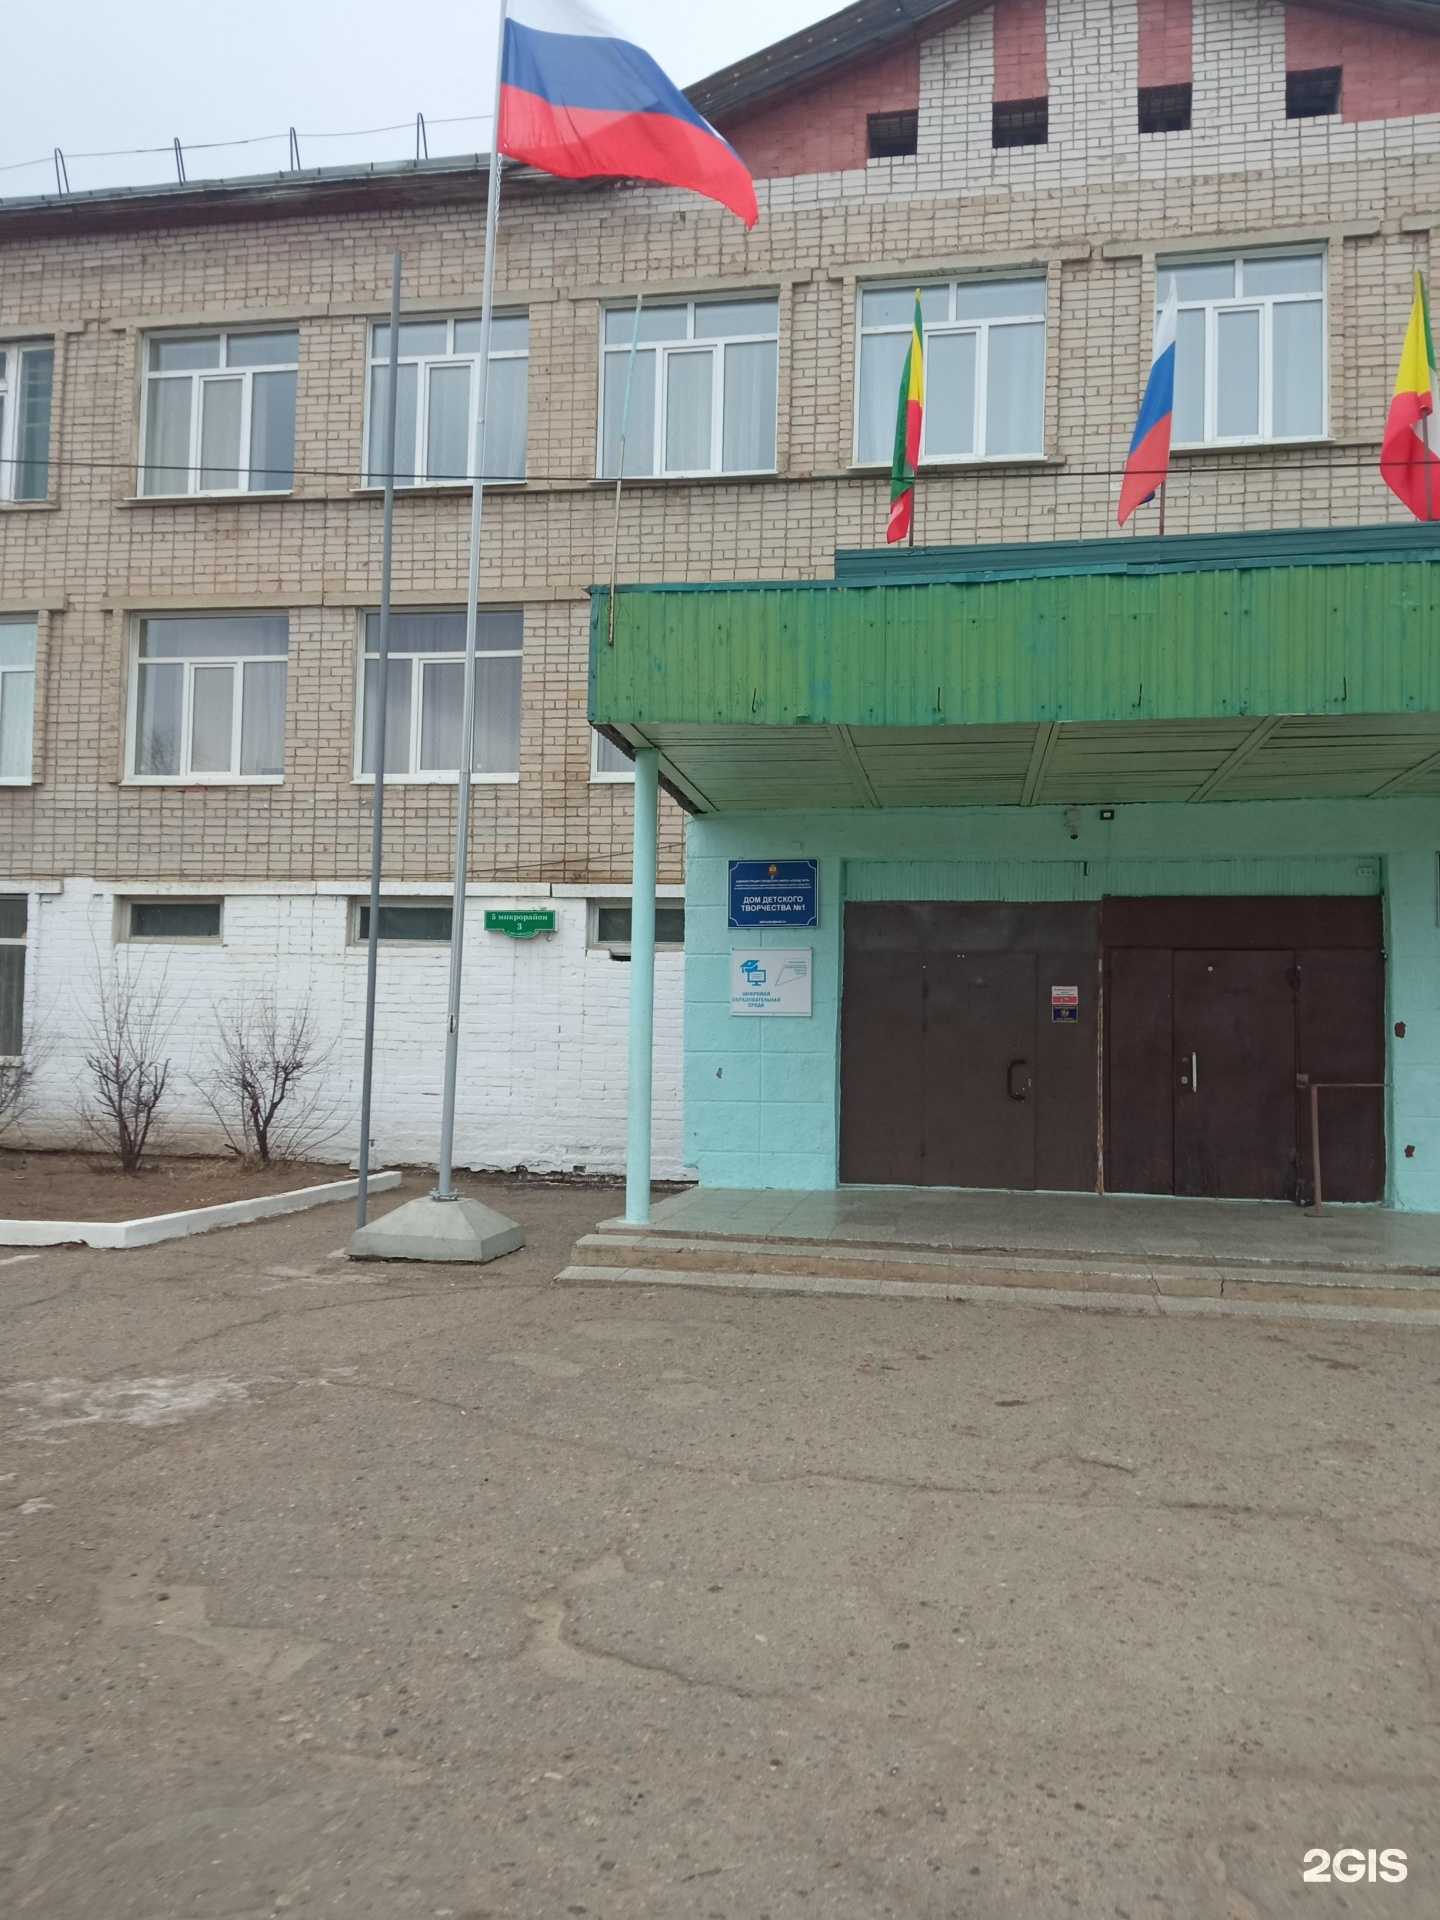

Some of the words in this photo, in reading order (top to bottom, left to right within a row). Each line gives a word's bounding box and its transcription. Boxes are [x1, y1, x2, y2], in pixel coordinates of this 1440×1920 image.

[743, 896, 761, 904] ДОМ
[762, 896, 803, 904] ДЕТСКОГО
[498, 914, 548, 922] микрорайон
